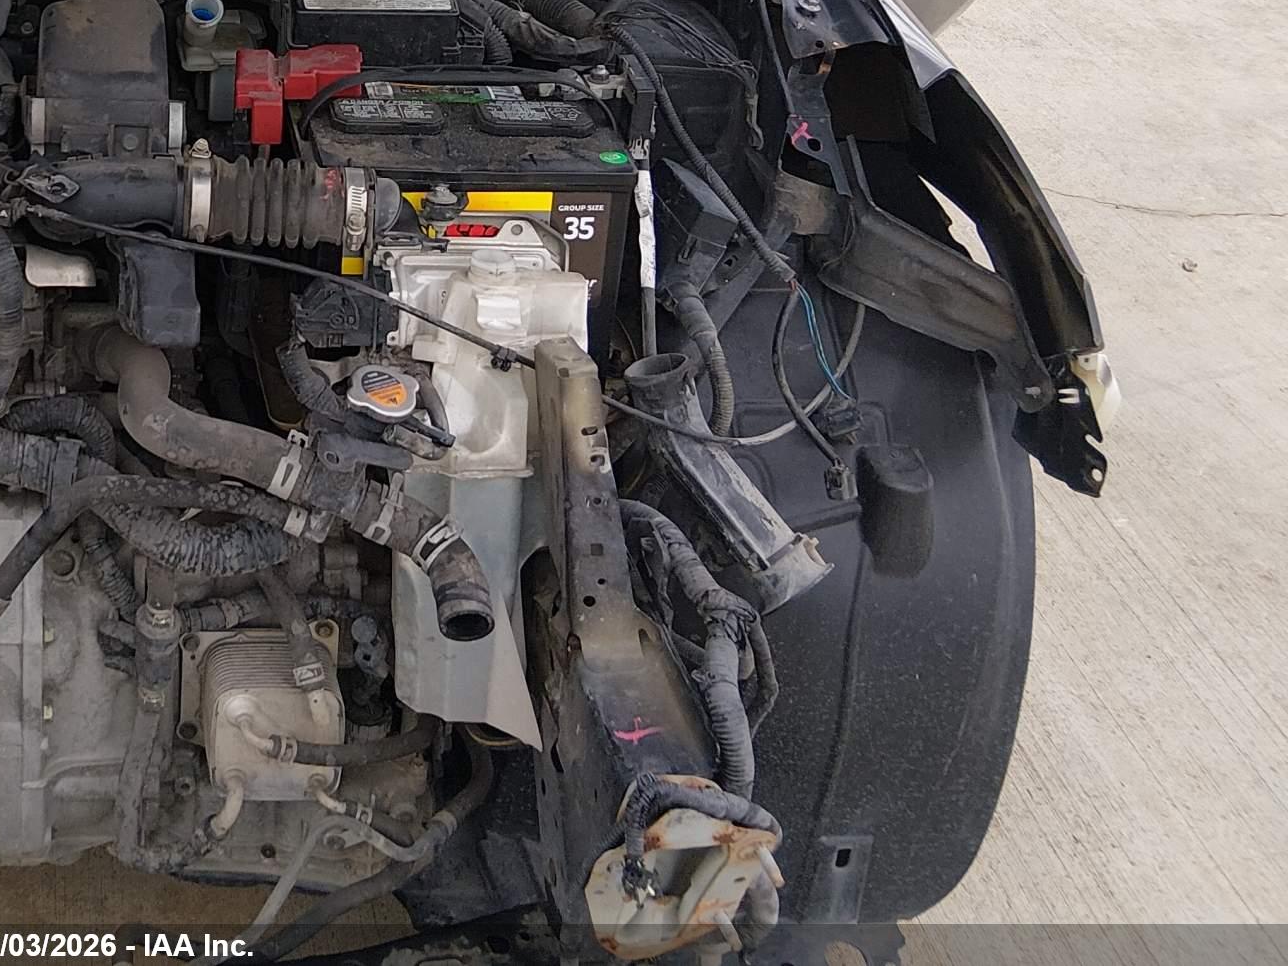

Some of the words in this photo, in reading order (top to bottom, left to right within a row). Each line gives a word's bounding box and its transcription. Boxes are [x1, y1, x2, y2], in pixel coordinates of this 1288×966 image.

[558, 204, 586, 212] GROUP
[587, 204, 605, 212] SIZE
[563, 216, 595, 240] 35
